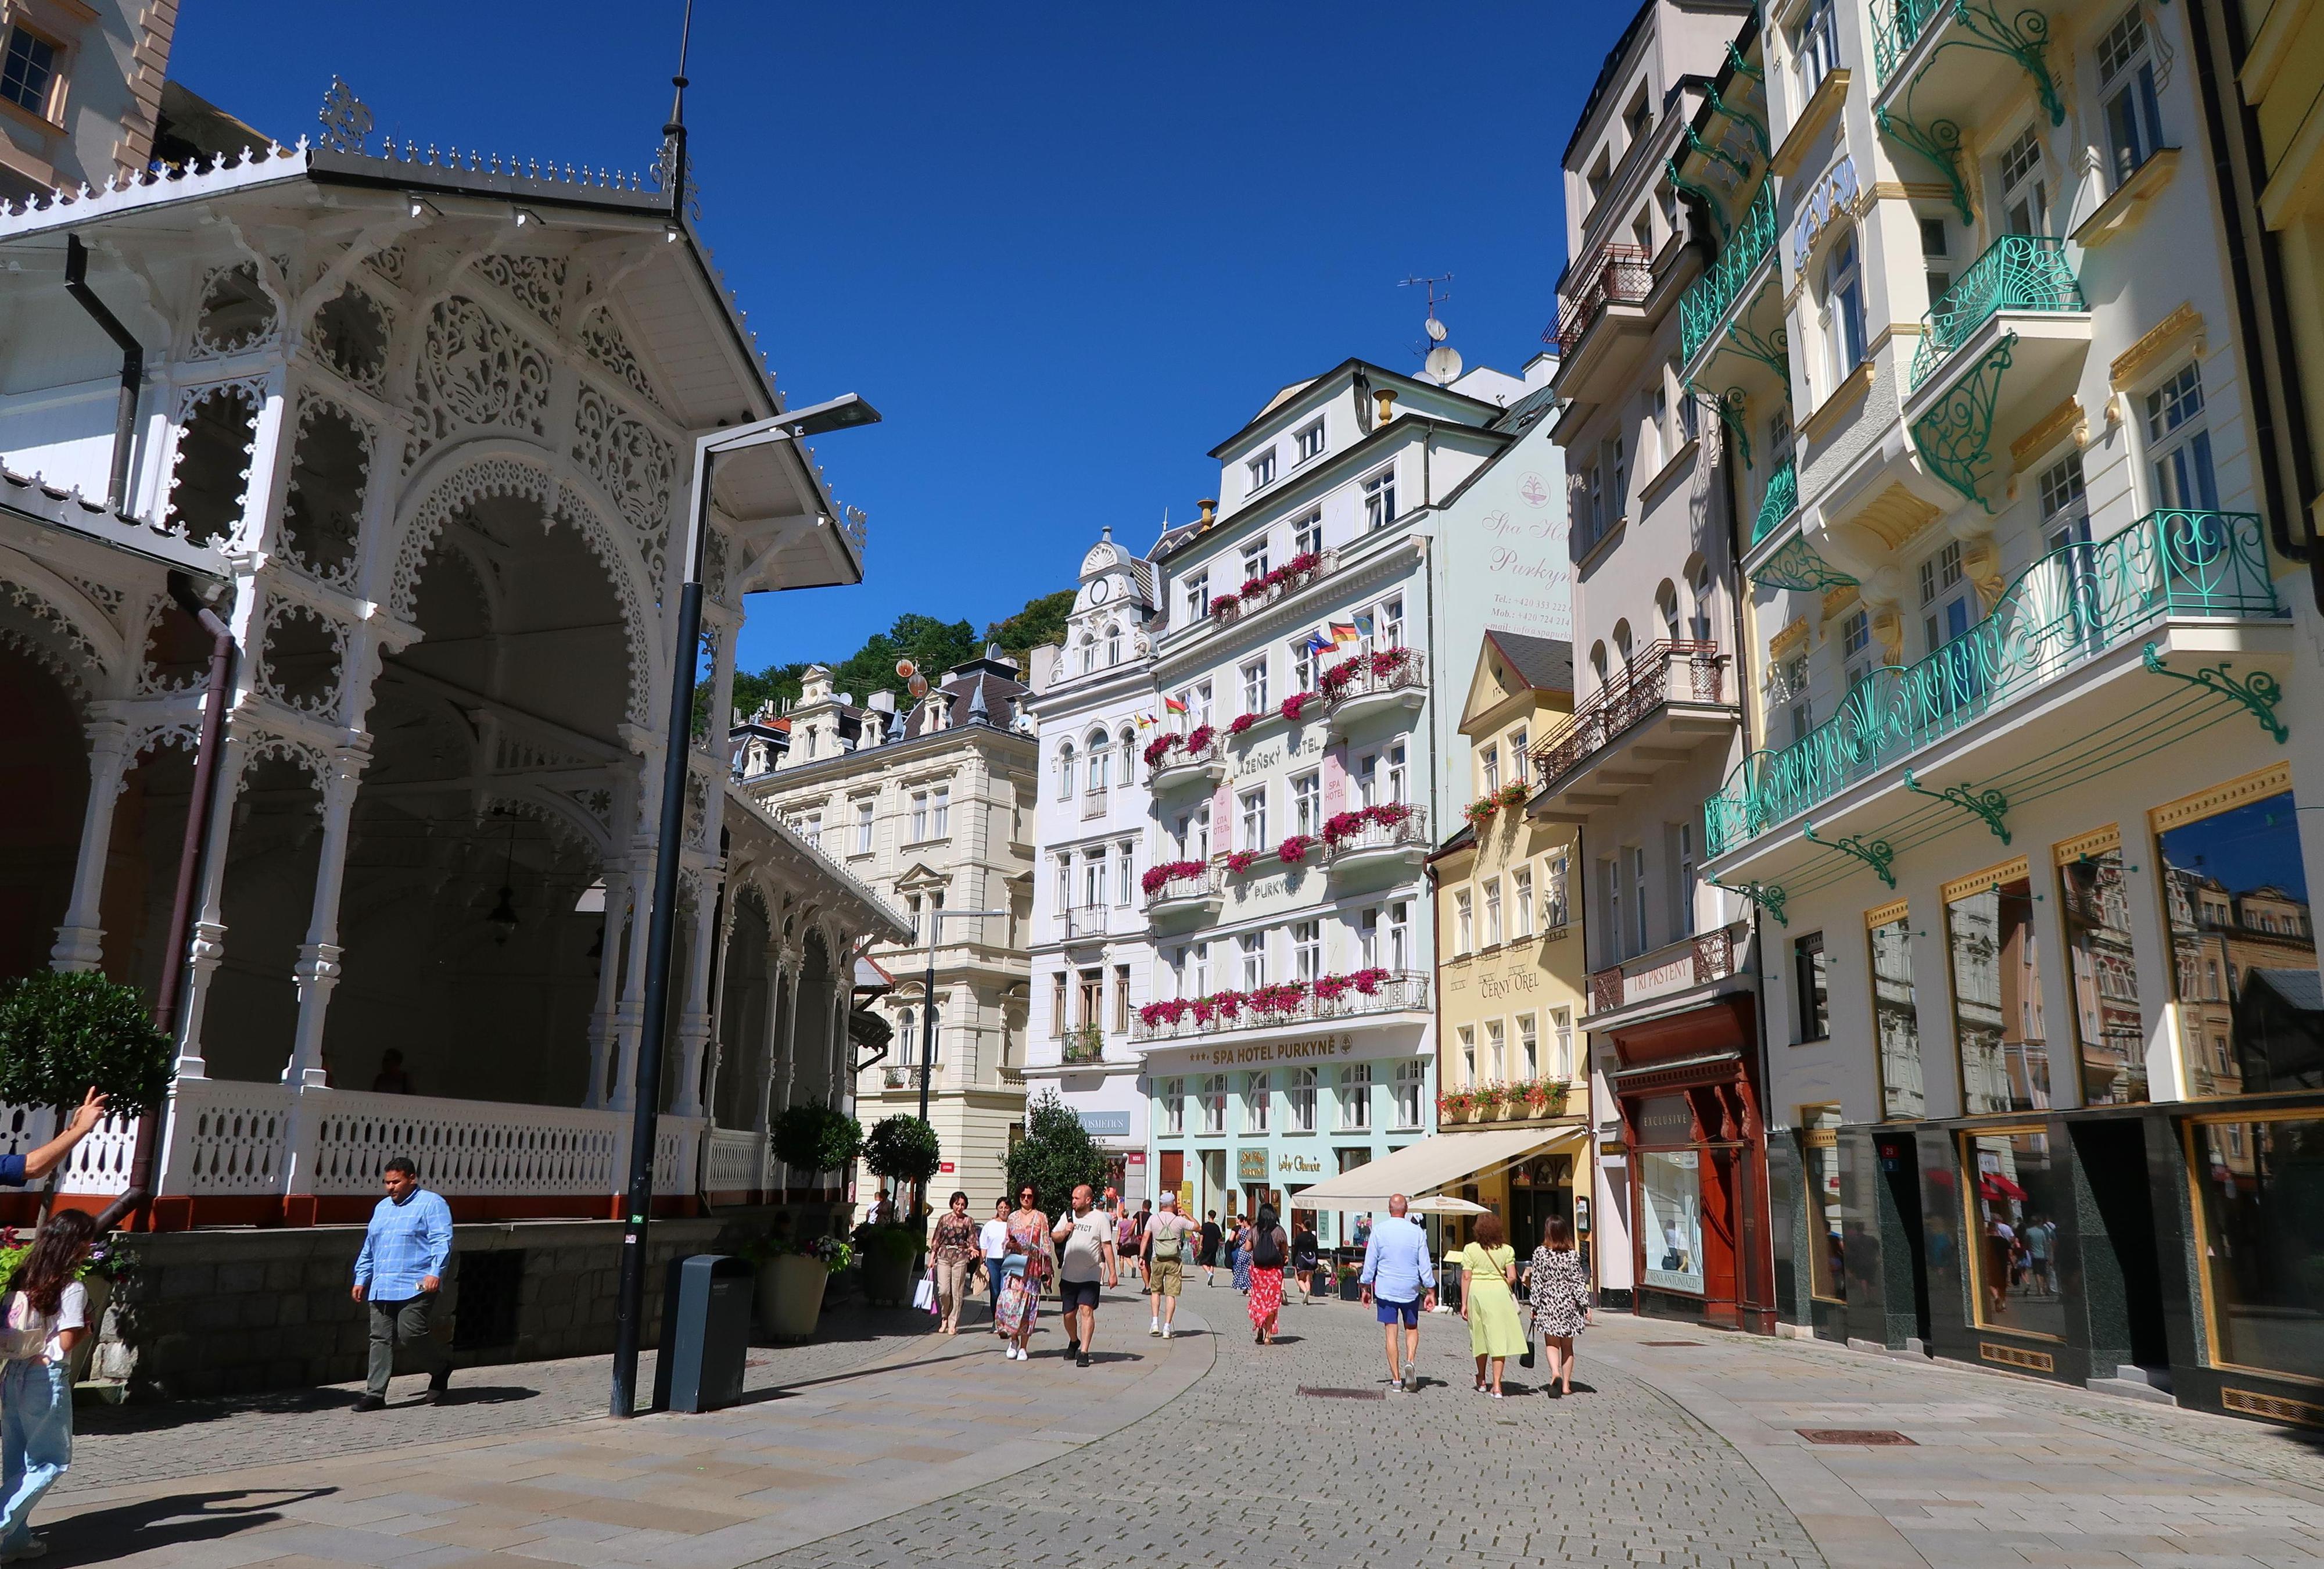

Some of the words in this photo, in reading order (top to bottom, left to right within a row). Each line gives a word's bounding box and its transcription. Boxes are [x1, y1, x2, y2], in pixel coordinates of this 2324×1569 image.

[1482, 510, 1521, 539] Spa
[1529, 519, 1569, 542] Ho
[1494, 594, 1511, 603] Tel.:
[1514, 598, 1533, 607] +420
[1536, 601, 1549, 609] 353
[1552, 603, 1566, 611] 222
[1491, 608, 1514, 618] Mob.:
[1518, 612, 1537, 621] +420
[1540, 615, 1553, 624] 724
[1555, 617, 1569, 626] 214
[1329, 779, 1340, 790] SPA
[1325, 789, 1344, 801] HOTEL
[1217, 815, 1227, 825] СПА
[1648, 959, 1687, 987] PRSTENY
[1515, 973, 1539, 992] OREL
[1213, 1049, 1233, 1065] SPA
[1238, 1047, 1274, 1063] HOTEL
[1278, 1034, 1335, 1059] PURKYNĚ
[1644, 1114, 1686, 1126] EXCLUSIVE
